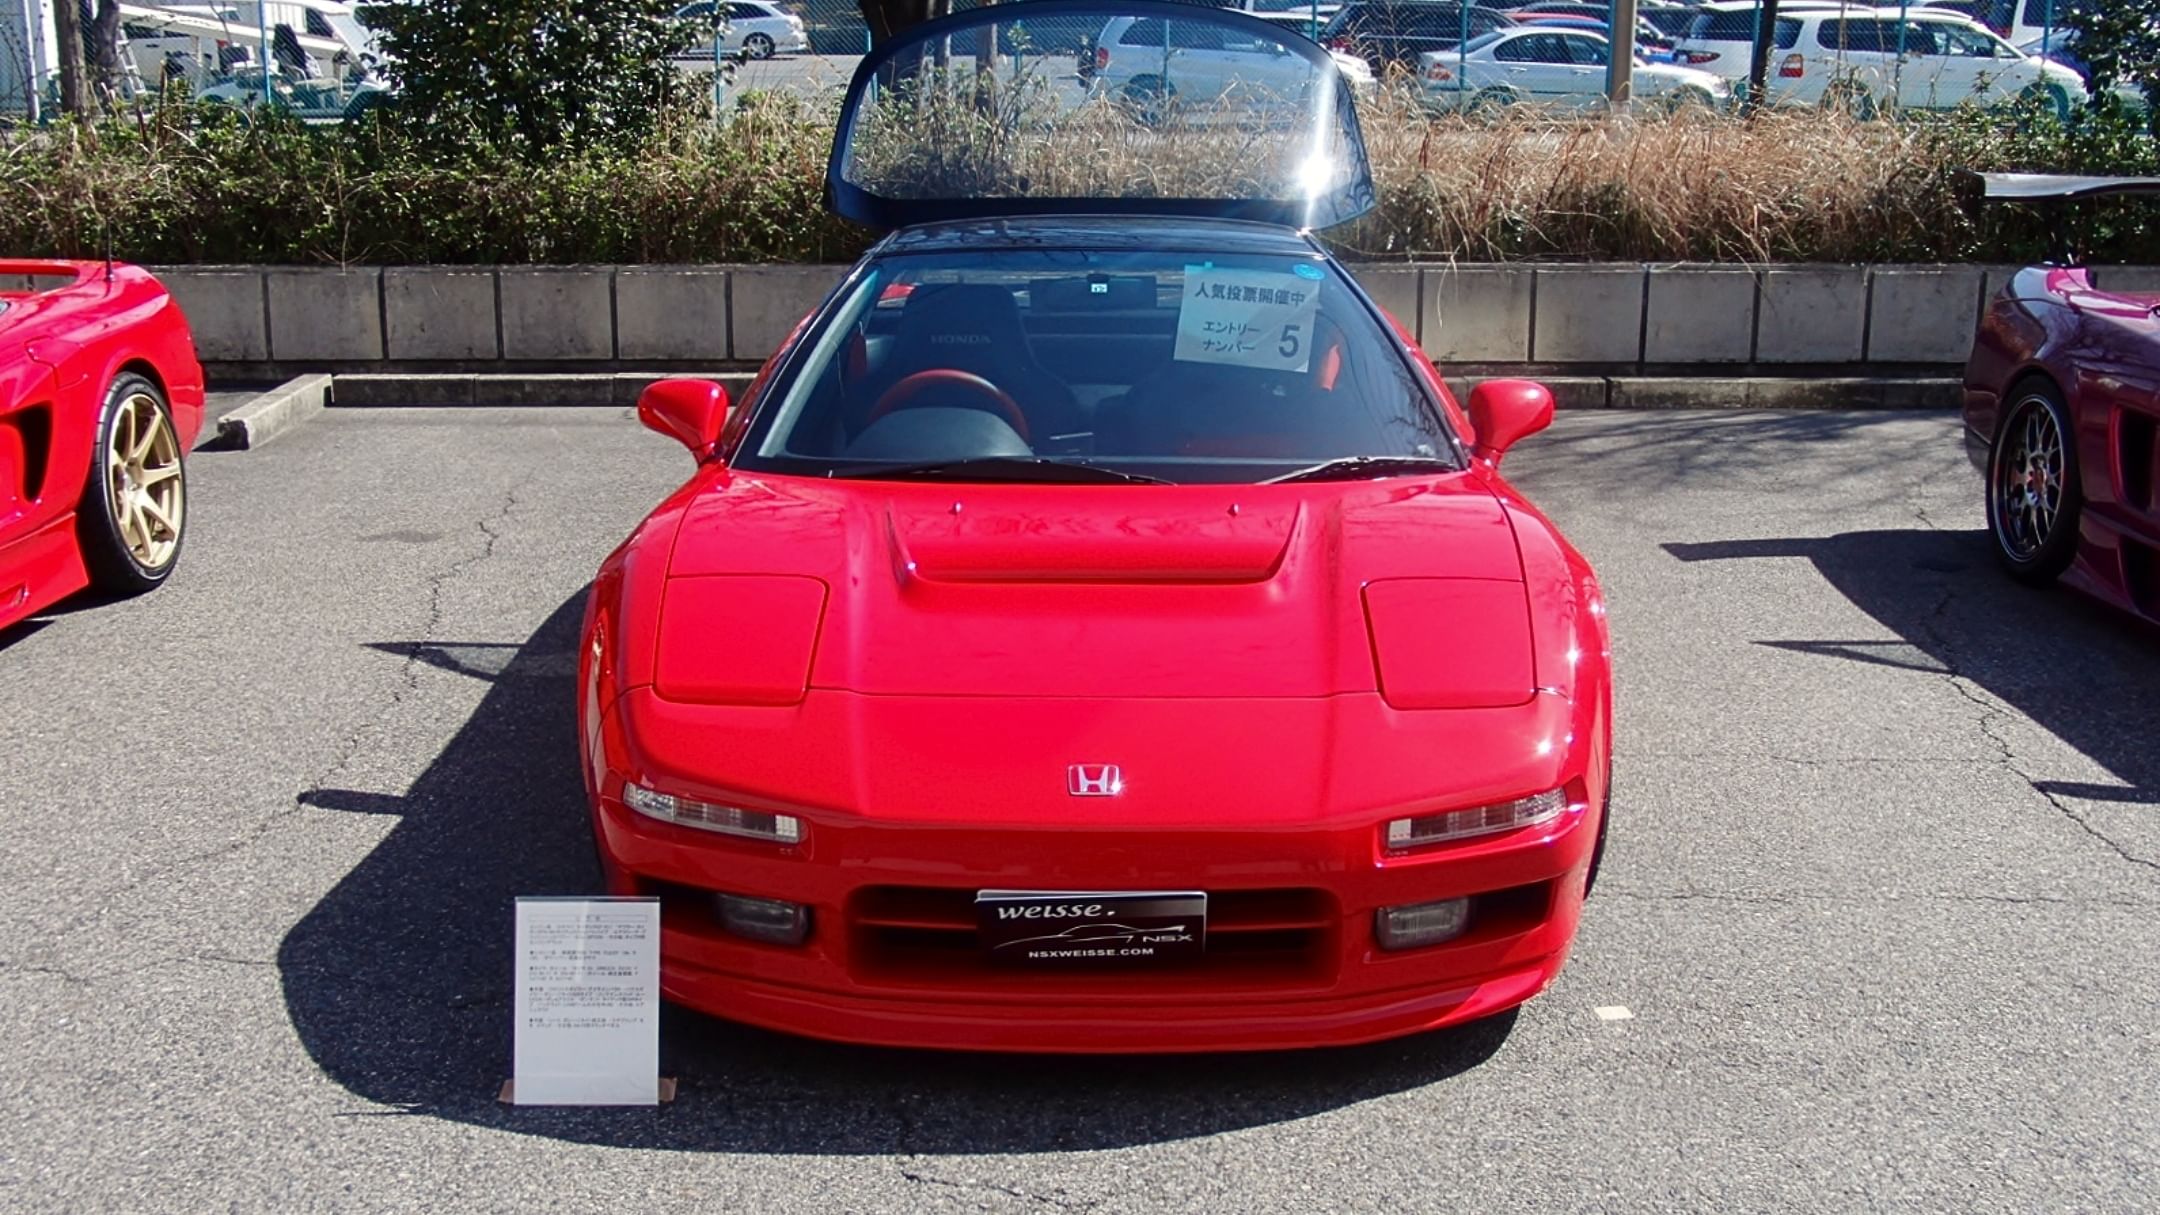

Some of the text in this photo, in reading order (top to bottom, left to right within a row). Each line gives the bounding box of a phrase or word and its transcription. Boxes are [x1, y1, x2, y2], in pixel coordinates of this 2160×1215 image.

[1194, 282, 1306, 307] 人気投票開催中
[1202, 320, 1260, 336] エントリー
[931, 335, 992, 344] HONDA
[1202, 338, 1256, 353] ナンバー
[1278, 324, 1301, 358] 5
[1142, 934, 1193, 943] NSX
[1028, 947, 1154, 958] NSXWEISSE.COM
